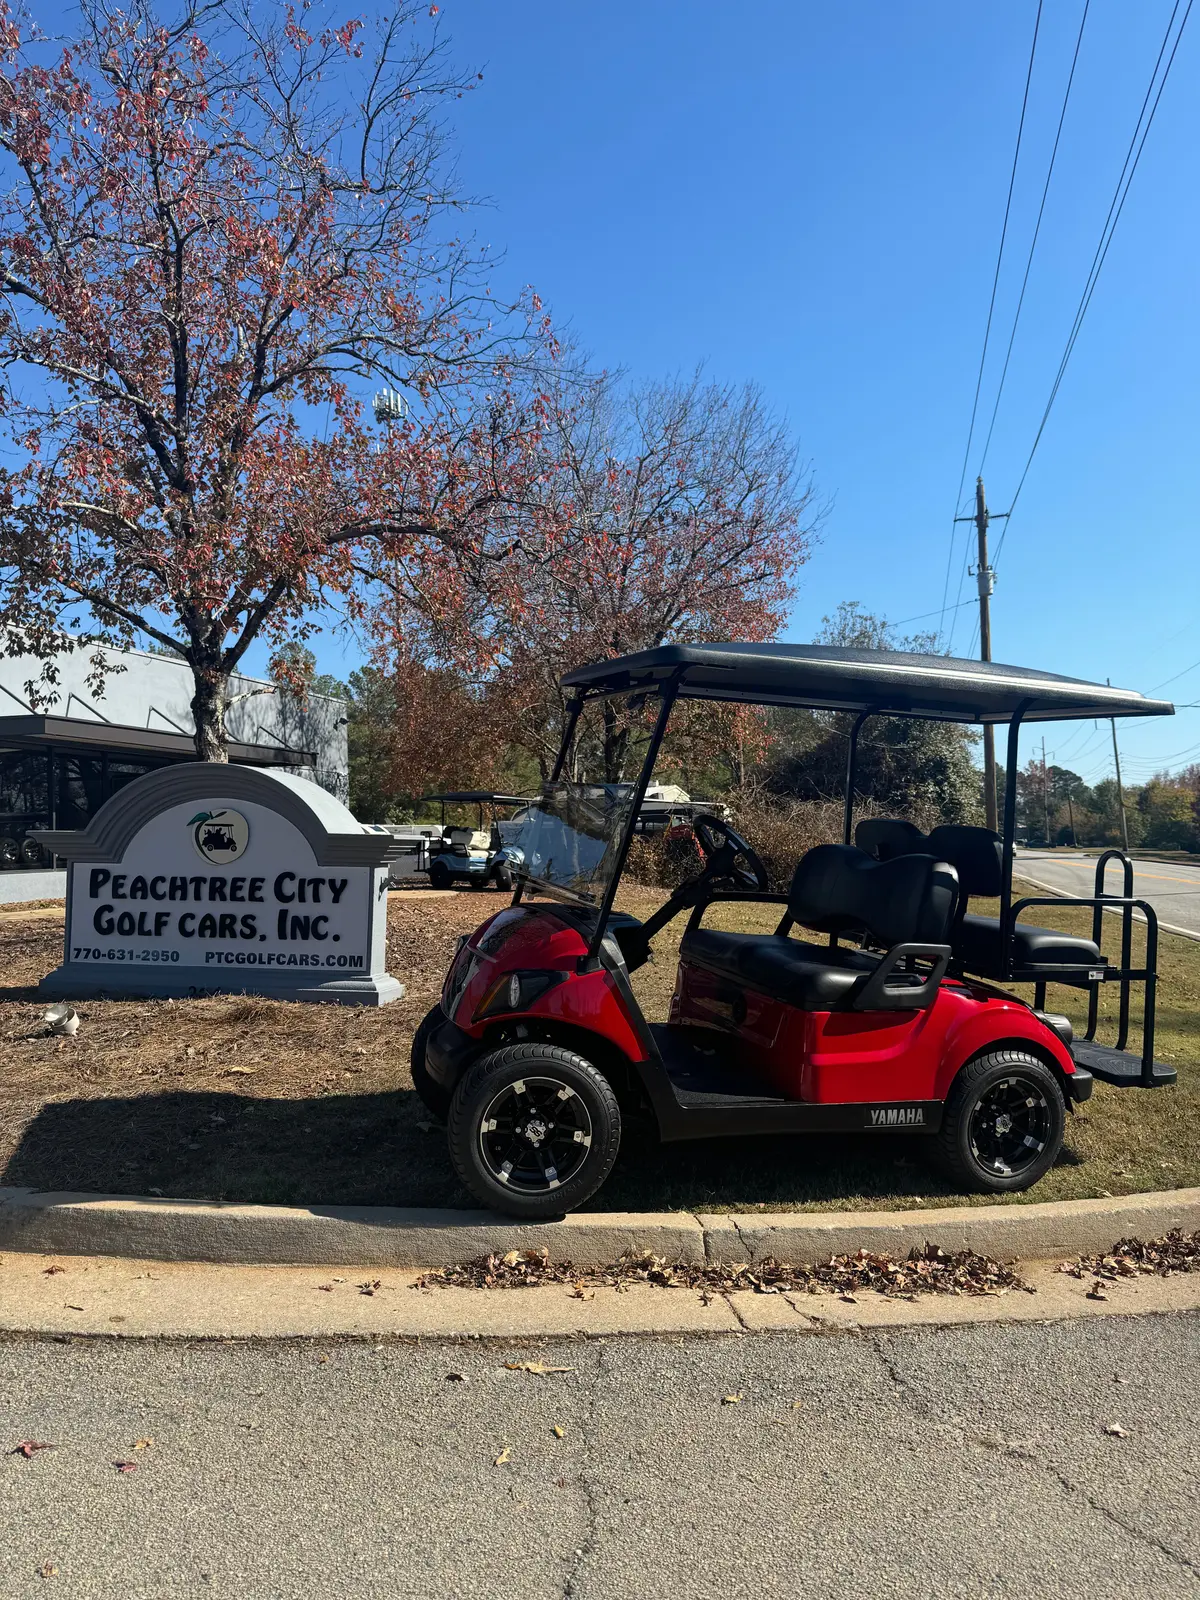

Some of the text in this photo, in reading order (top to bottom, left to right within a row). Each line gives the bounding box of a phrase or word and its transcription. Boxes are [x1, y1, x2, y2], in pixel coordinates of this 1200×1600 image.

[89, 868, 348, 903] PEACHTREE CITY
[93, 904, 341, 942] GOLF CARS, INC.
[73, 947, 180, 963] 770-631-2950
[205, 951, 364, 968] PTCGOLFCARS.COM
[870, 1108, 924, 1124] YAMAHA
